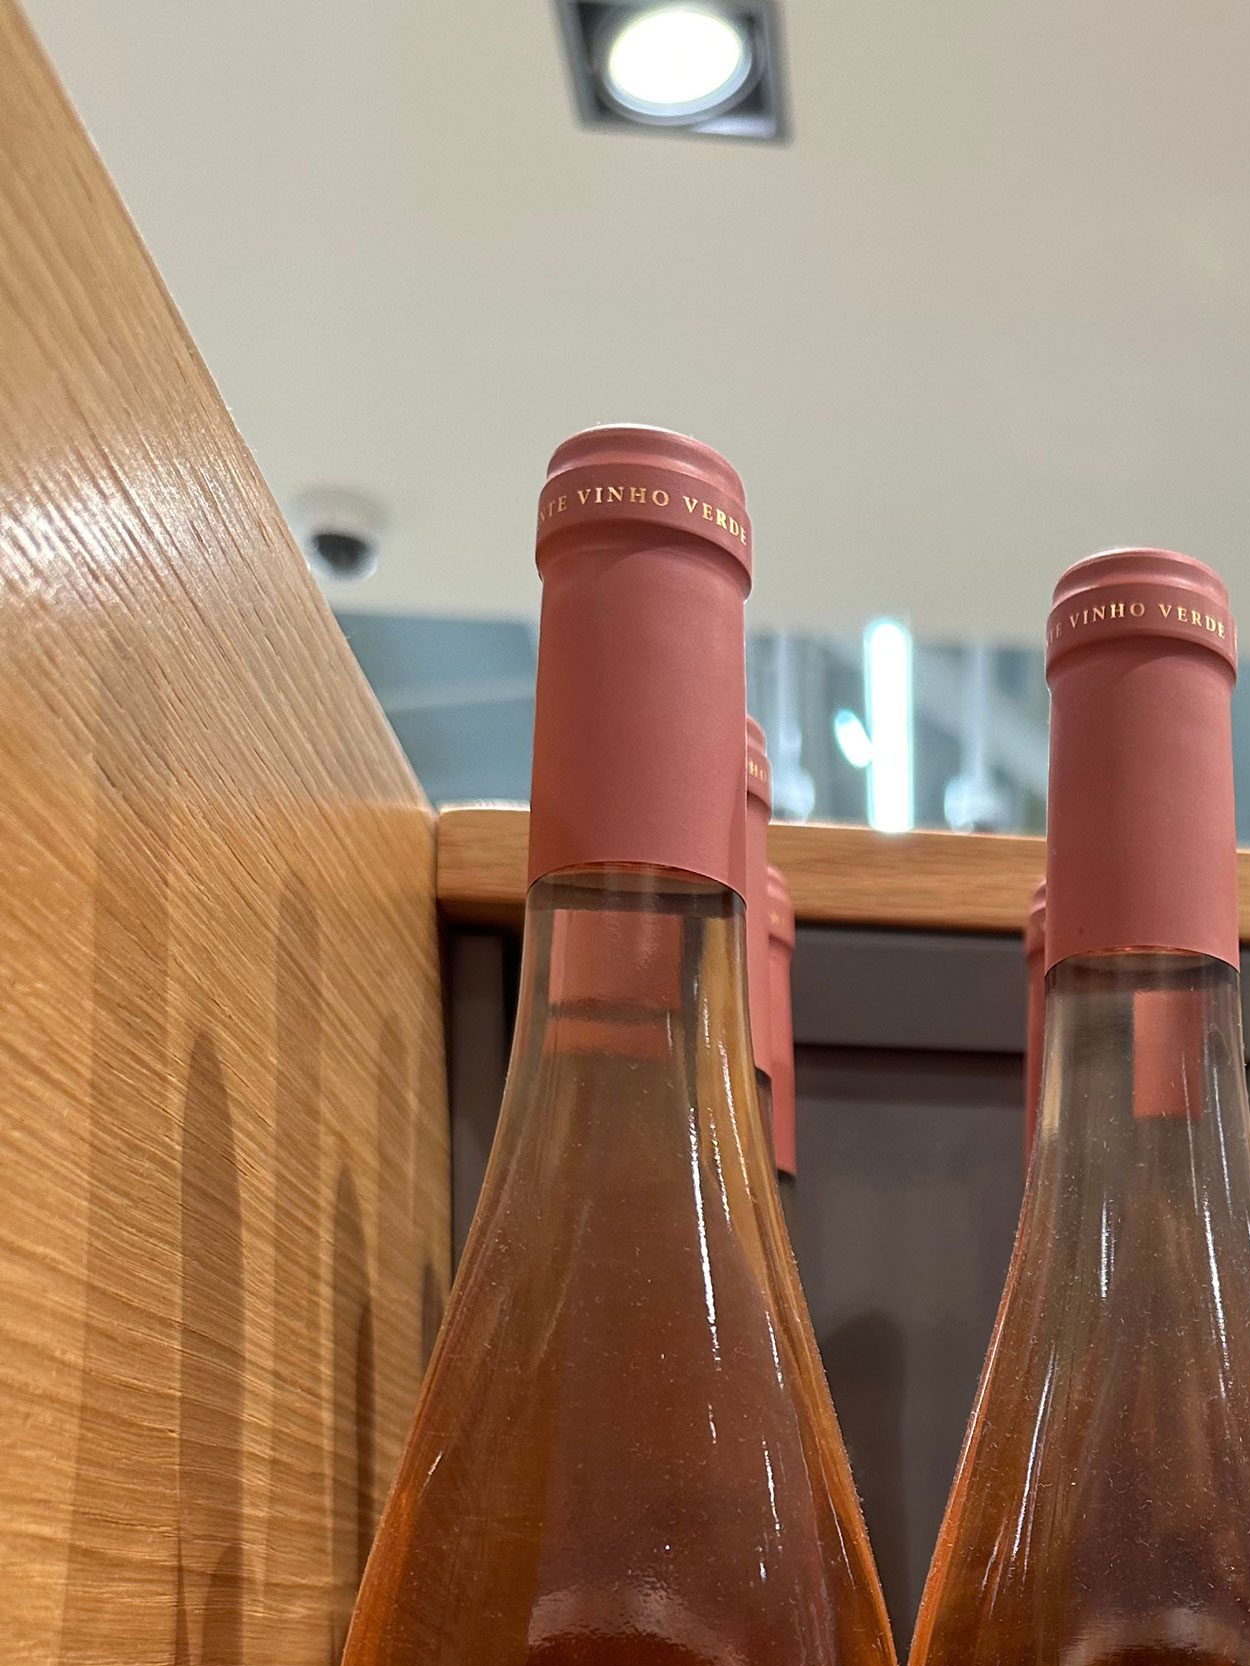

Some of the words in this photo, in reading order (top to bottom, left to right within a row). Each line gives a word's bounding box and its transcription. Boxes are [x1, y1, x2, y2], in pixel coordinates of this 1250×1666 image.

[577, 486, 670, 507] VINHO
[682, 495, 748, 547] VERDE
[1069, 602, 1146, 629] VINHO
[1157, 603, 1226, 640] VERDE
